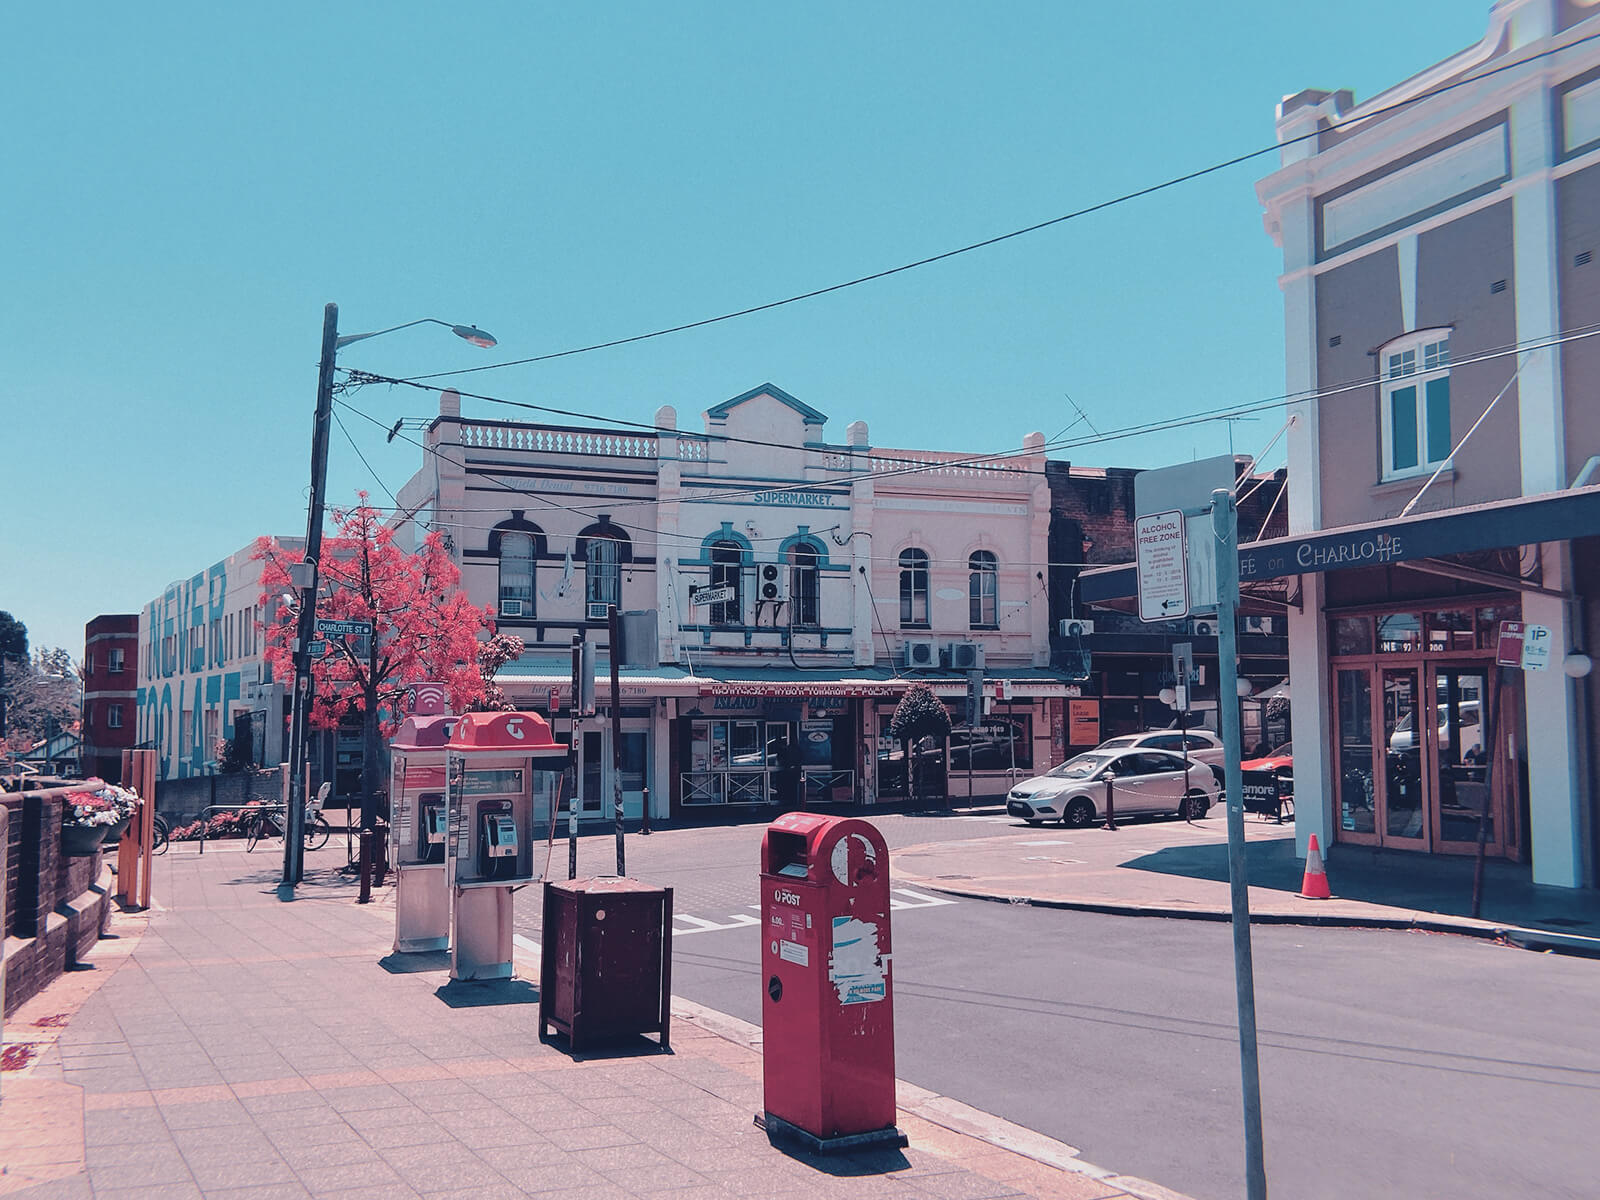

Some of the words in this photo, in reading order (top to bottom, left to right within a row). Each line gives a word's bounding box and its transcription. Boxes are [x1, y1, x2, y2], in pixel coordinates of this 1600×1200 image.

[1141, 522, 1177, 535] ALCOHOL
[1139, 535, 1158, 545] FREE
[1159, 531, 1181, 542] ZONE
[1239, 554, 1257, 576] FÉ
[1267, 558, 1285, 570] on
[148, 560, 228, 682] NEVER
[1508, 623, 1519, 632] NO
[318, 622, 353, 633] CHARLOTTE
[354, 625, 364, 634] ST
[1532, 630, 1547, 641] 1P
[781, 892, 801, 906] POST
